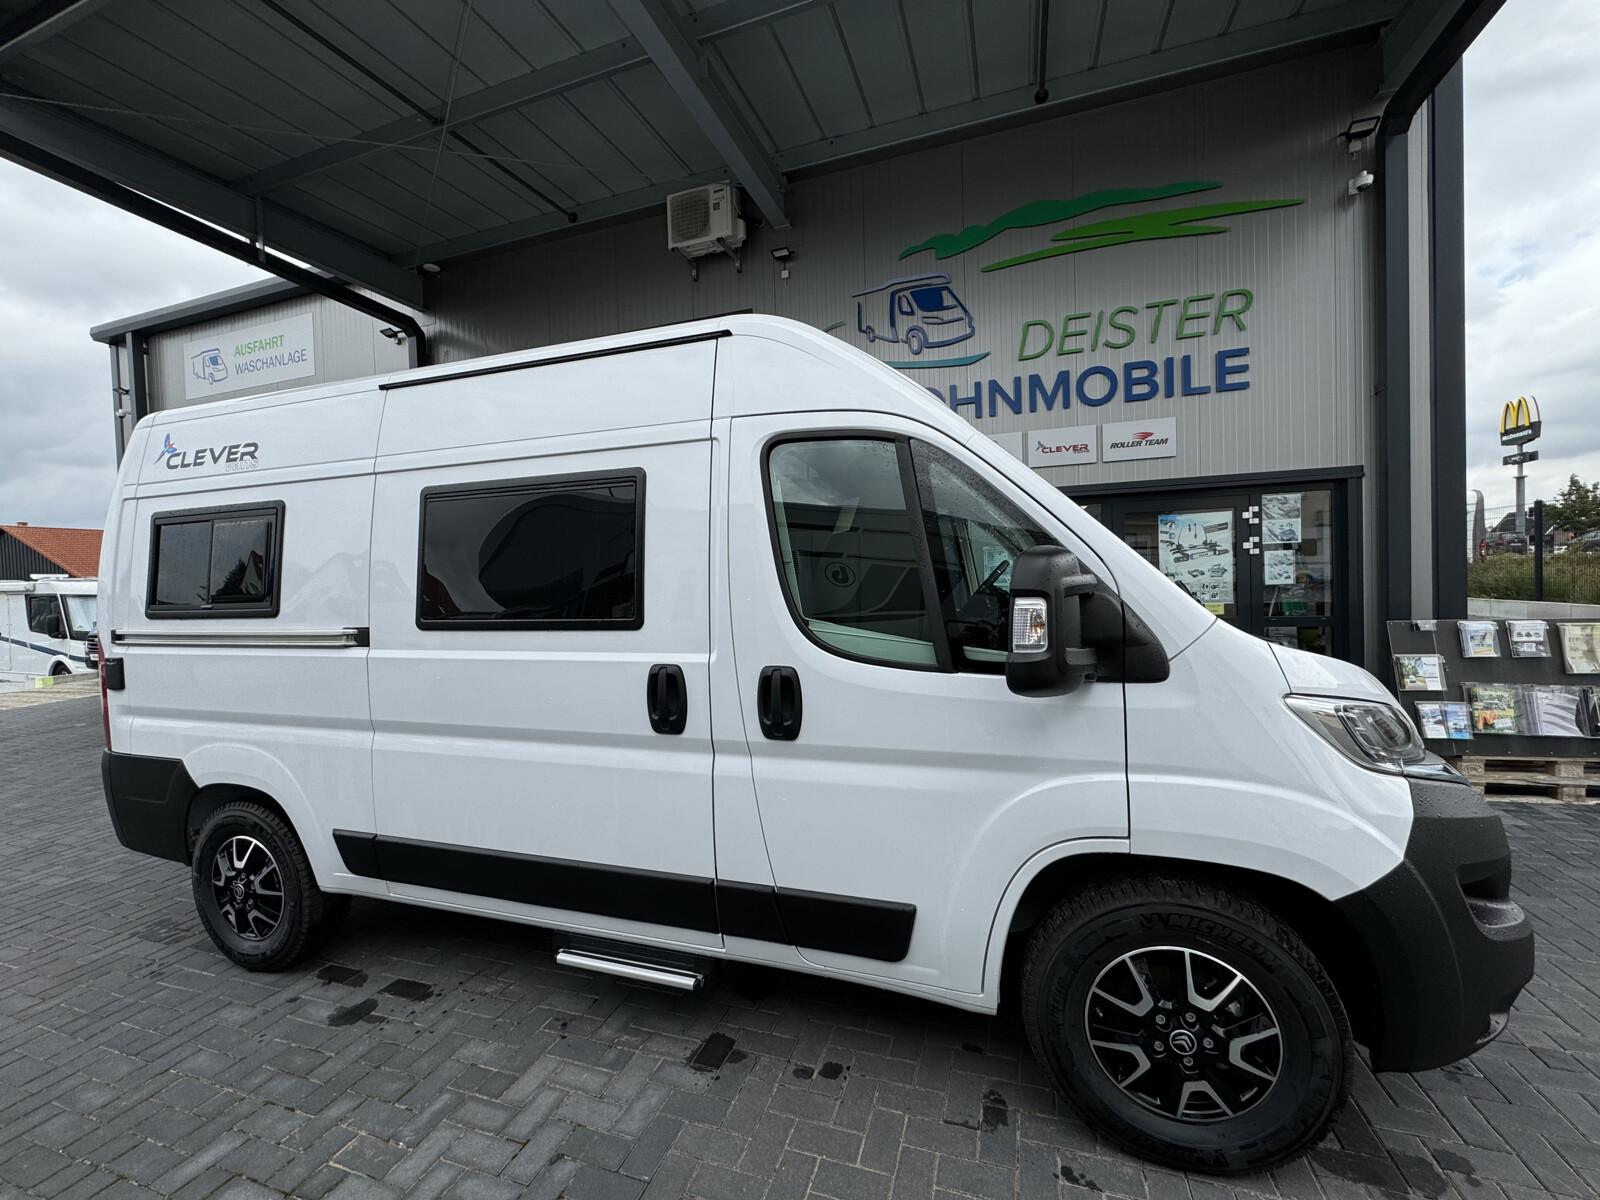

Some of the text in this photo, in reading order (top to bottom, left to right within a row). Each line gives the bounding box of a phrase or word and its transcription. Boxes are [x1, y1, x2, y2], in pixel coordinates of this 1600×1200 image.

[1018, 288, 1254, 361] DEISTER
[234, 334, 285, 357] AUSFAHRT
[234, 348, 308, 375] WASCHANLAGE
[926, 347, 1250, 419] HNMOBILE
[166, 442, 260, 470] CLEVER
[1041, 443, 1090, 454] CLEVER
[1110, 437, 1169, 450] ROLLER TEAM
